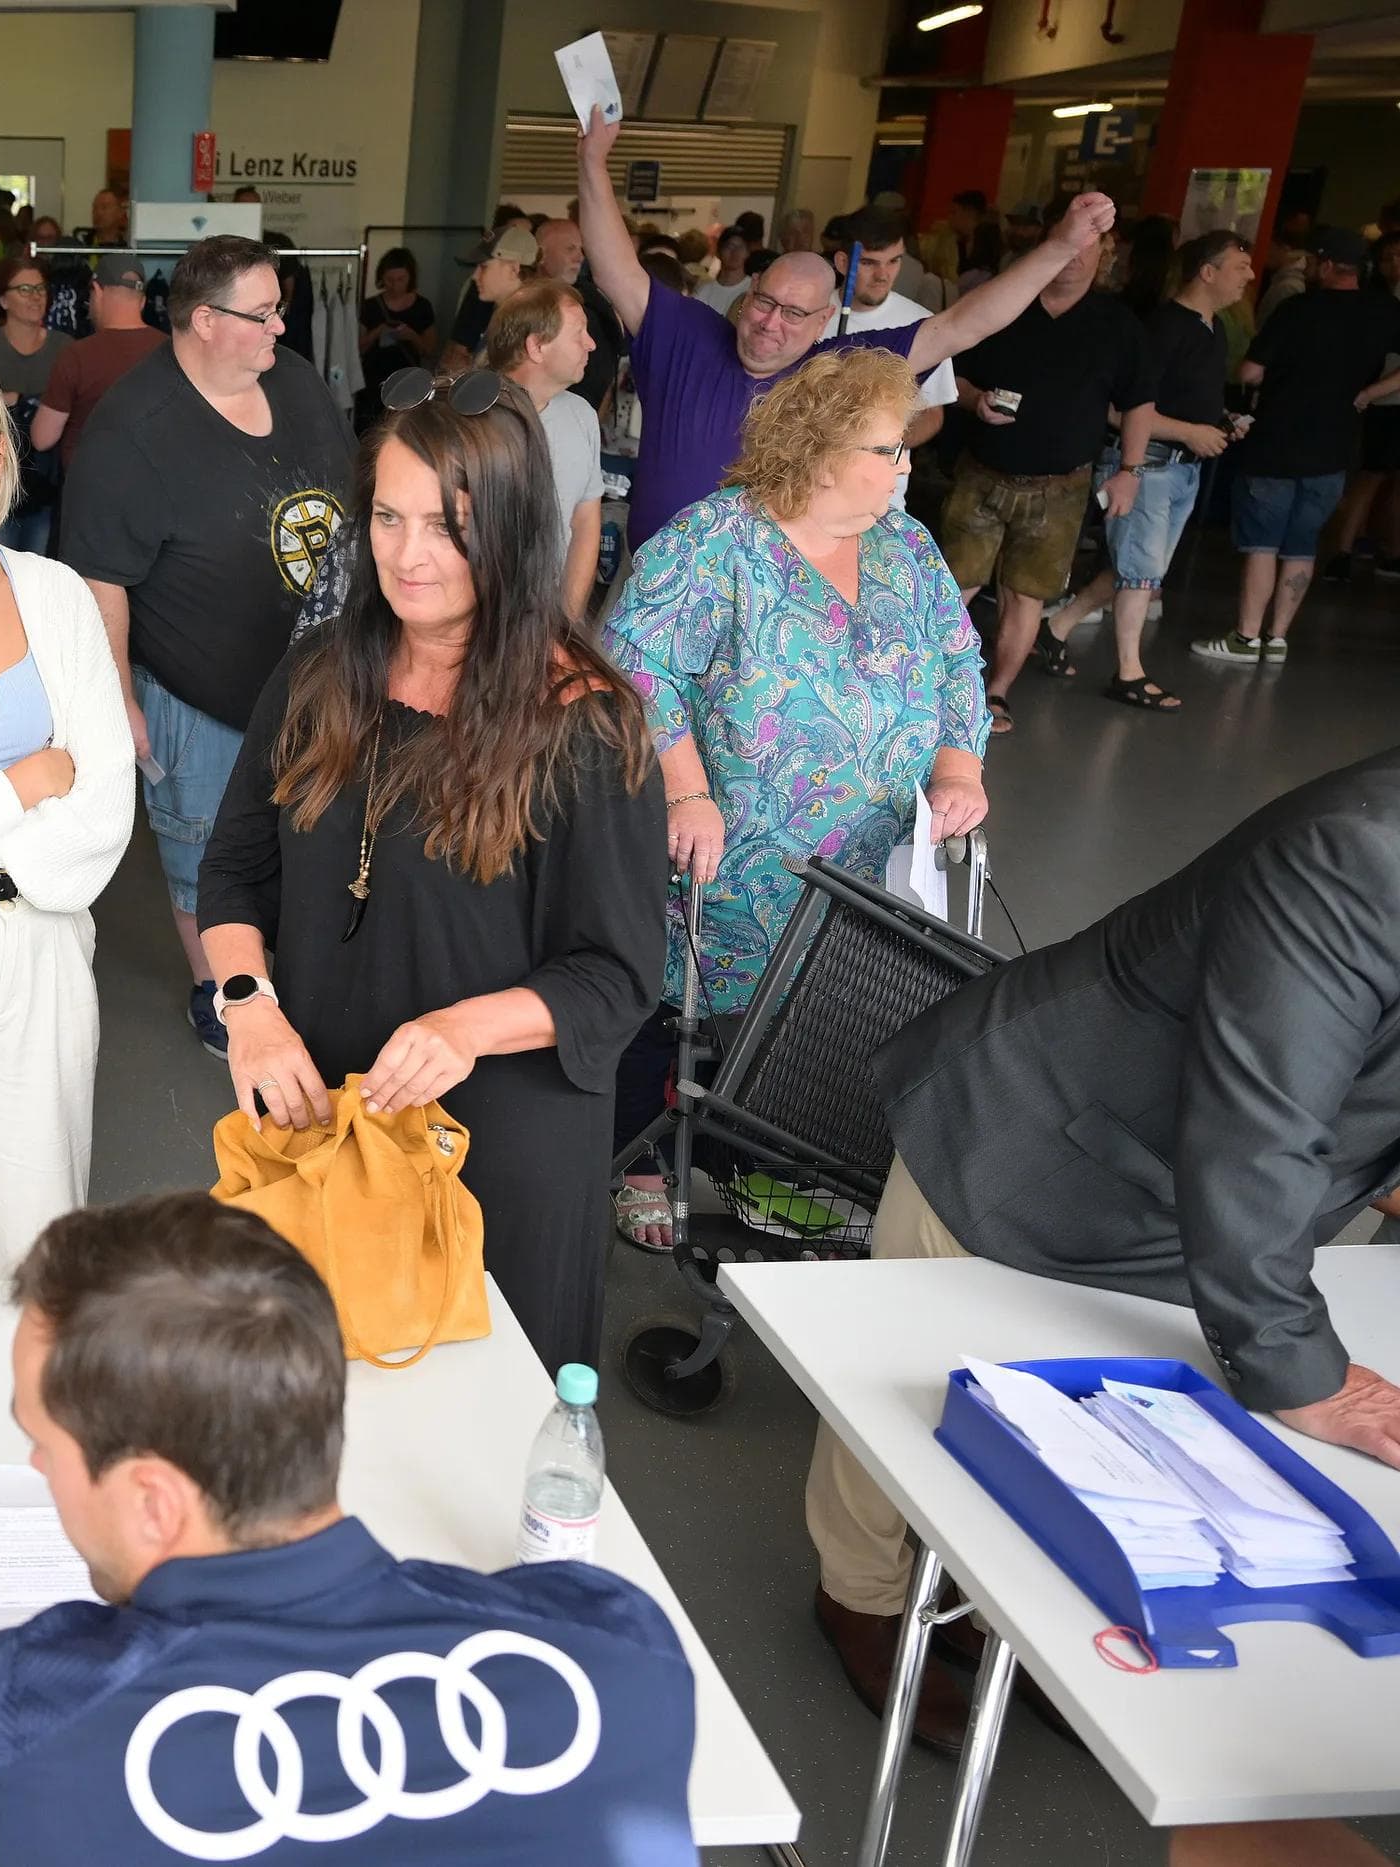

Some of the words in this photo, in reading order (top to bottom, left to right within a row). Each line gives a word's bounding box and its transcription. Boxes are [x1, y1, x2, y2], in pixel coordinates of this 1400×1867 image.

[1094, 115, 1122, 154] E
[230, 152, 285, 177] Lenz
[292, 152, 357, 177] Kraus
